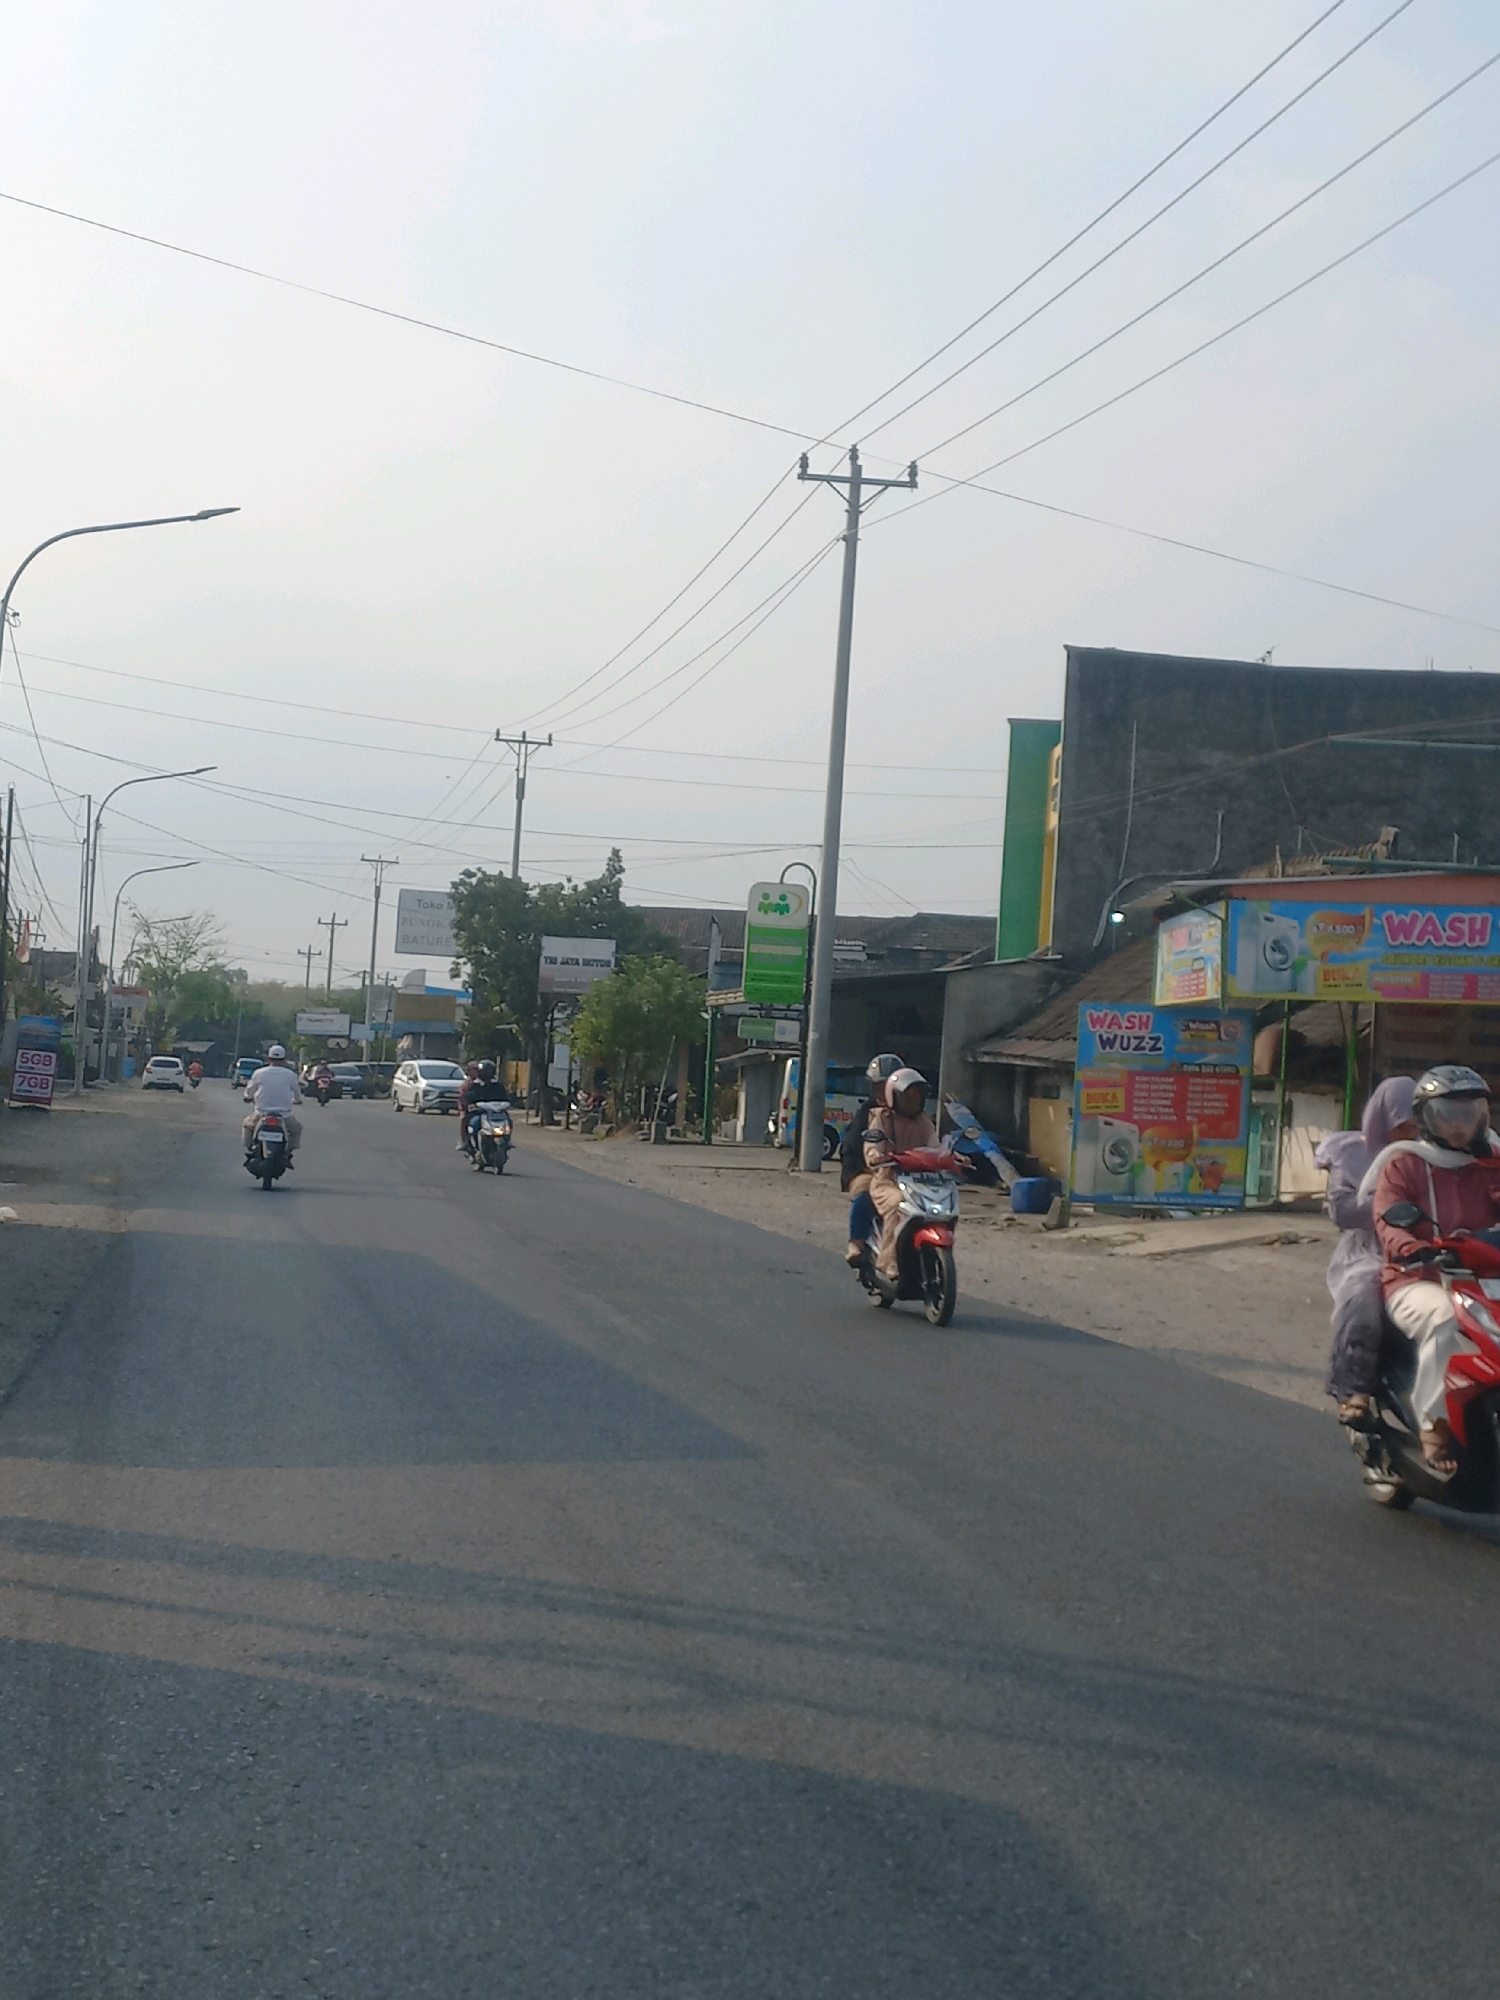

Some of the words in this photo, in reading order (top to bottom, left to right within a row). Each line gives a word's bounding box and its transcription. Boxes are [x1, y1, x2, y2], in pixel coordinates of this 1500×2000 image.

[416, 898, 444, 910] Toko
[1383, 910, 1491, 946] WASH
[402, 934, 452, 948] BATURE
[1087, 1011, 1152, 1031] WASH
[1098, 1033, 1163, 1053] WUZZ
[20, 1051, 53, 1067] 5GB
[17, 1075, 50, 1090] 7GB
